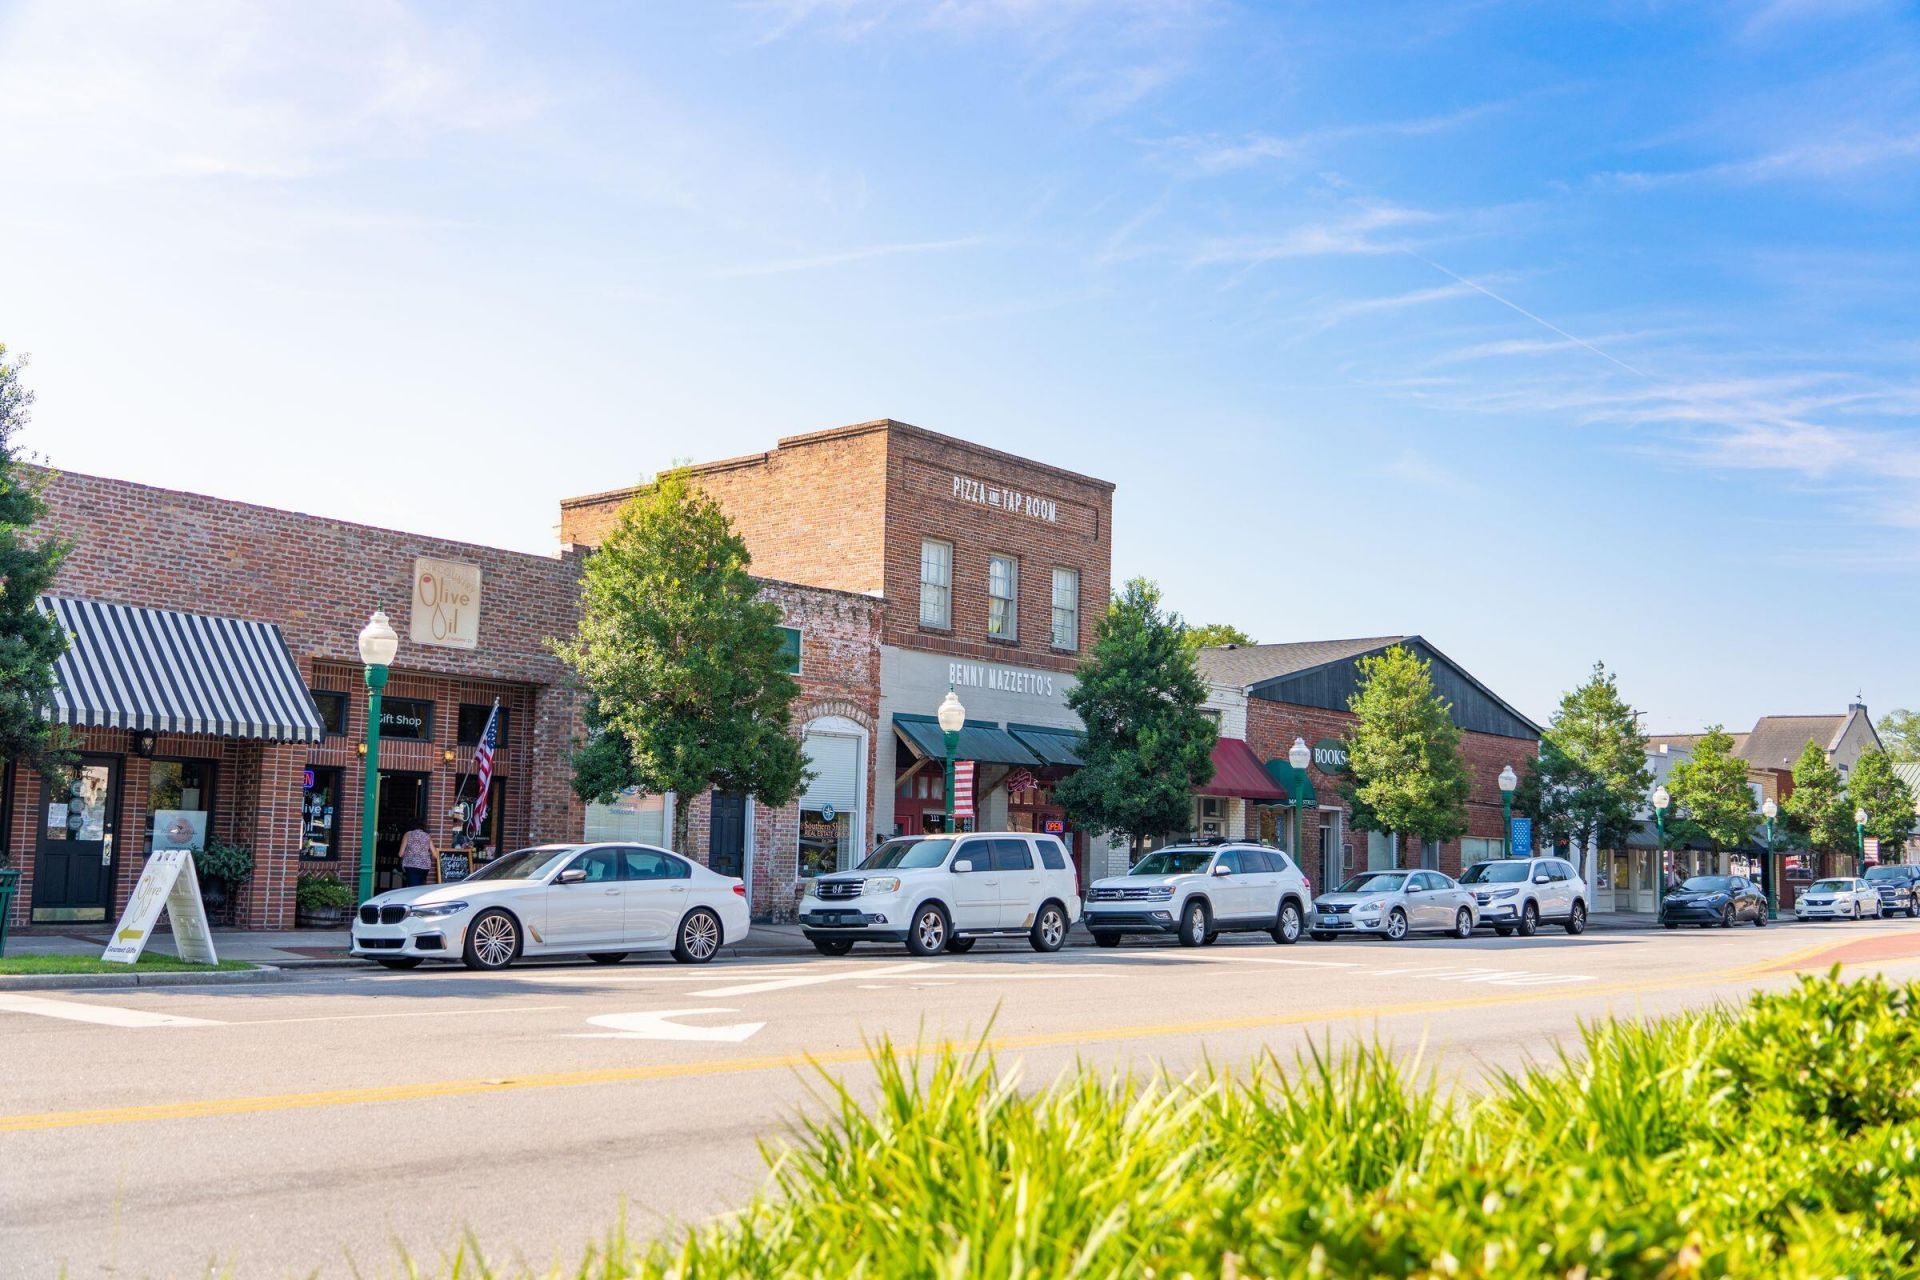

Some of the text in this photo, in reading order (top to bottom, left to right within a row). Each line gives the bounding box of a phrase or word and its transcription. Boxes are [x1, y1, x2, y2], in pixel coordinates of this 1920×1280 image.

[953, 476, 1056, 523] PIZZA AND TAP ROOM
[419, 573, 470, 607] Olive
[432, 603, 458, 640] Oil
[949, 663, 1052, 697] BENNY MAZZETTO'S
[396, 714, 422, 727] Shop
[1314, 748, 1346, 766] BOOKS
[302, 797, 322, 813] live
[804, 820, 830, 831] Southern
[930, 814, 940, 822] 111
[1046, 822, 1063, 831] OPEN
